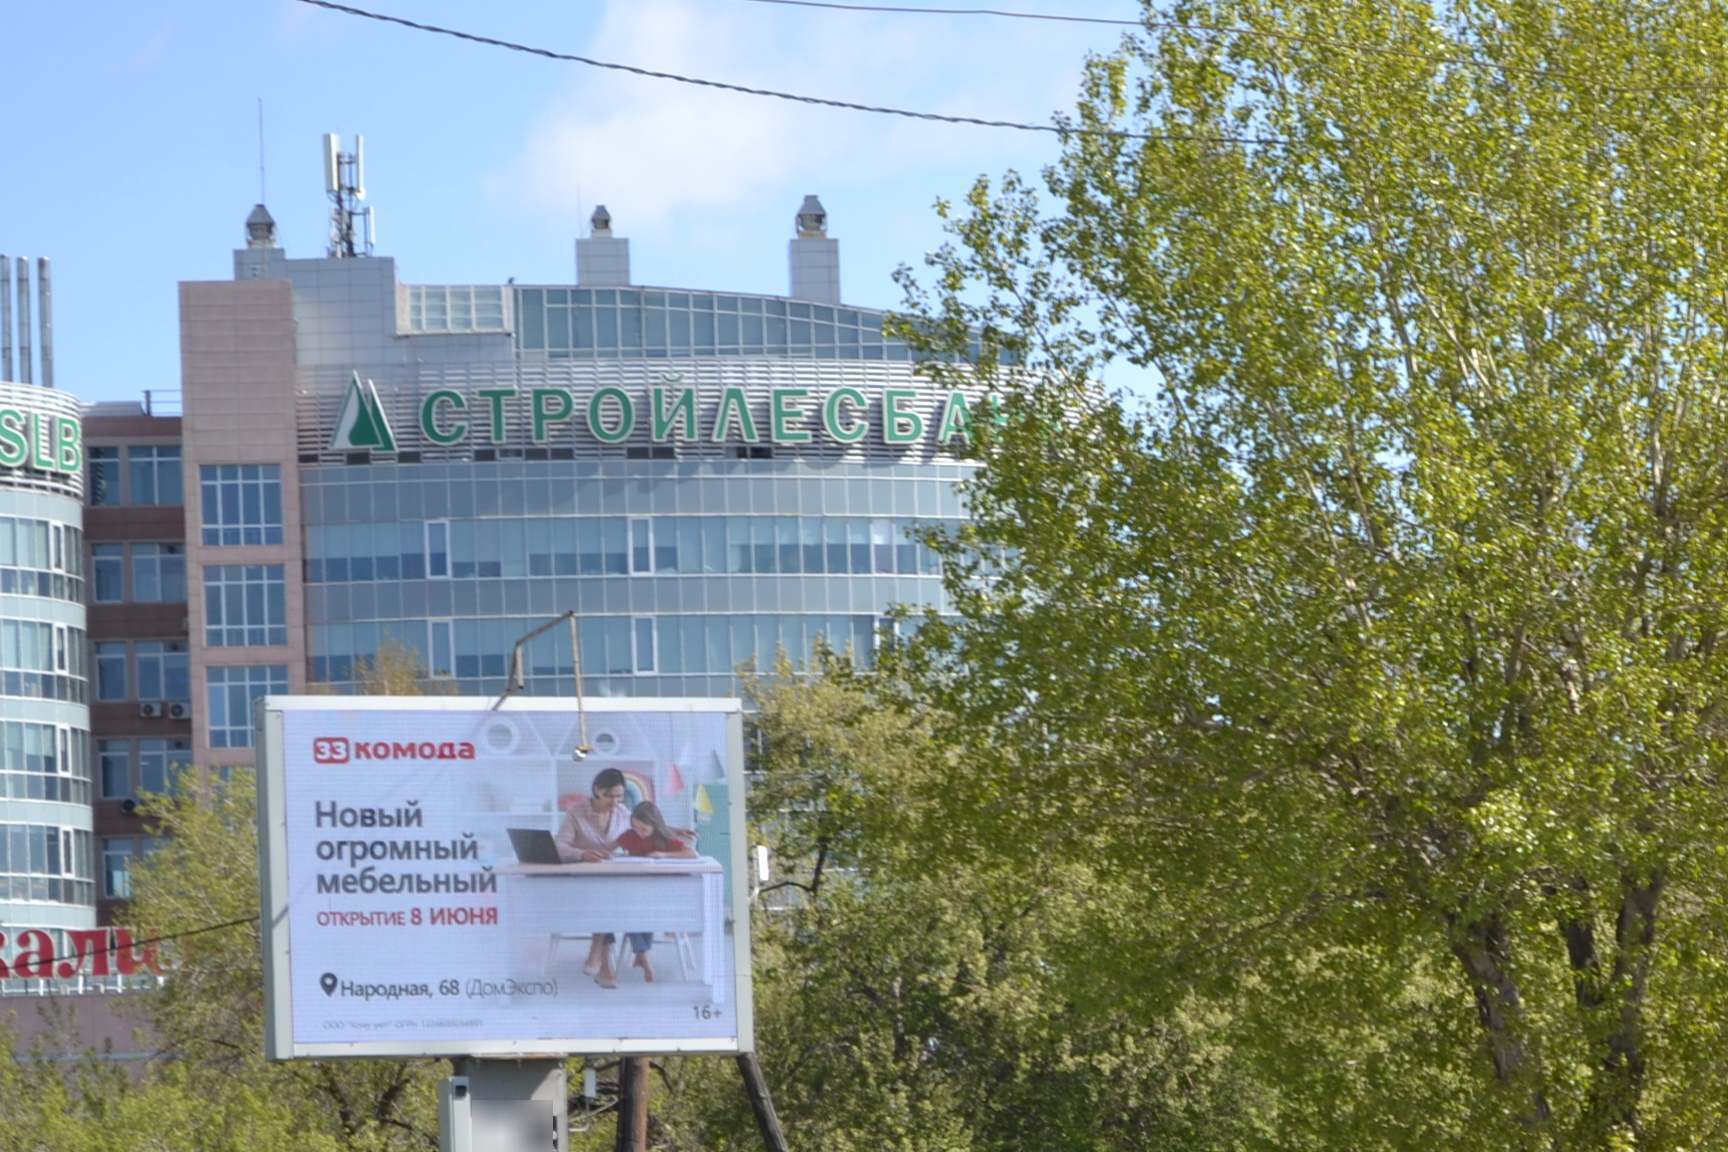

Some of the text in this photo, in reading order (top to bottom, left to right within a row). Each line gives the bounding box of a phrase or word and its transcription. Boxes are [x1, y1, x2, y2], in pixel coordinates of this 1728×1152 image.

[315, 739, 476, 762] 33 комода
[314, 800, 423, 828] Новый
[316, 832, 478, 868] огромный
[316, 866, 497, 894] мебельный
[317, 907, 498, 927] ОТКРЫТИЕ 8 ИЮНЯ
[340, 977, 559, 1000] Народная, 68 (ДомЭкспо)
[693, 1004, 722, 1020] 16+
